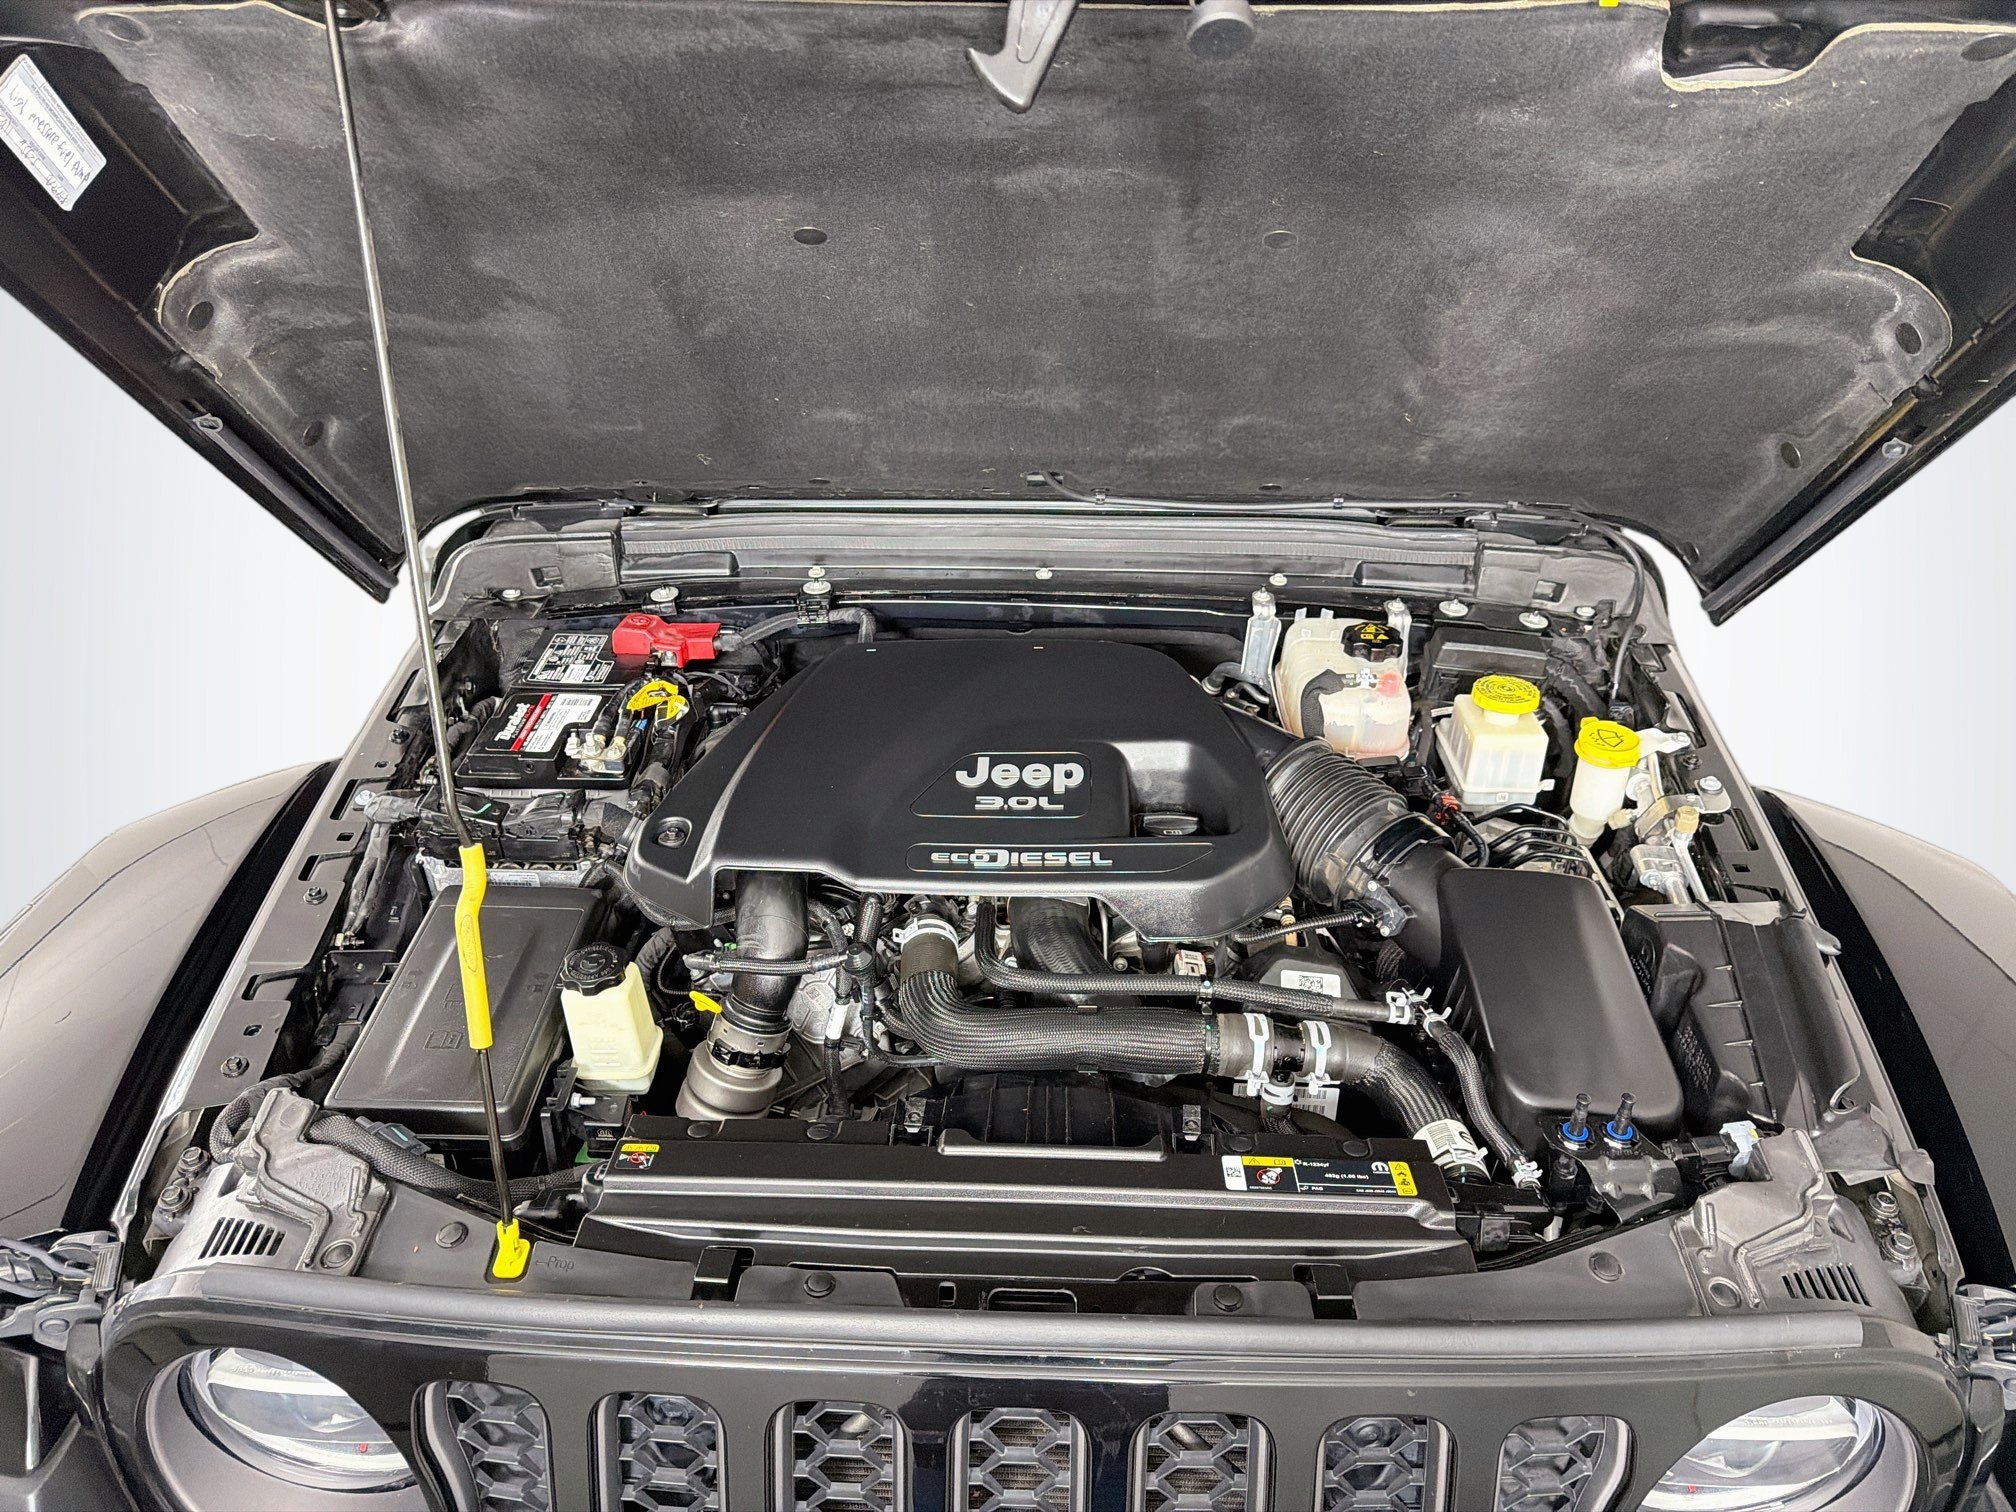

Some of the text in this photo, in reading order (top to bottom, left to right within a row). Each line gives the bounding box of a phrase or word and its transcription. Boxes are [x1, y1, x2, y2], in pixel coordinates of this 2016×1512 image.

[29, 114, 59, 144] pressure
[494, 703, 530, 740] Duralast
[955, 756, 1084, 794] Jeep
[975, 796, 1064, 811] 3.0L
[546, 1256, 575, 1271] Prop
